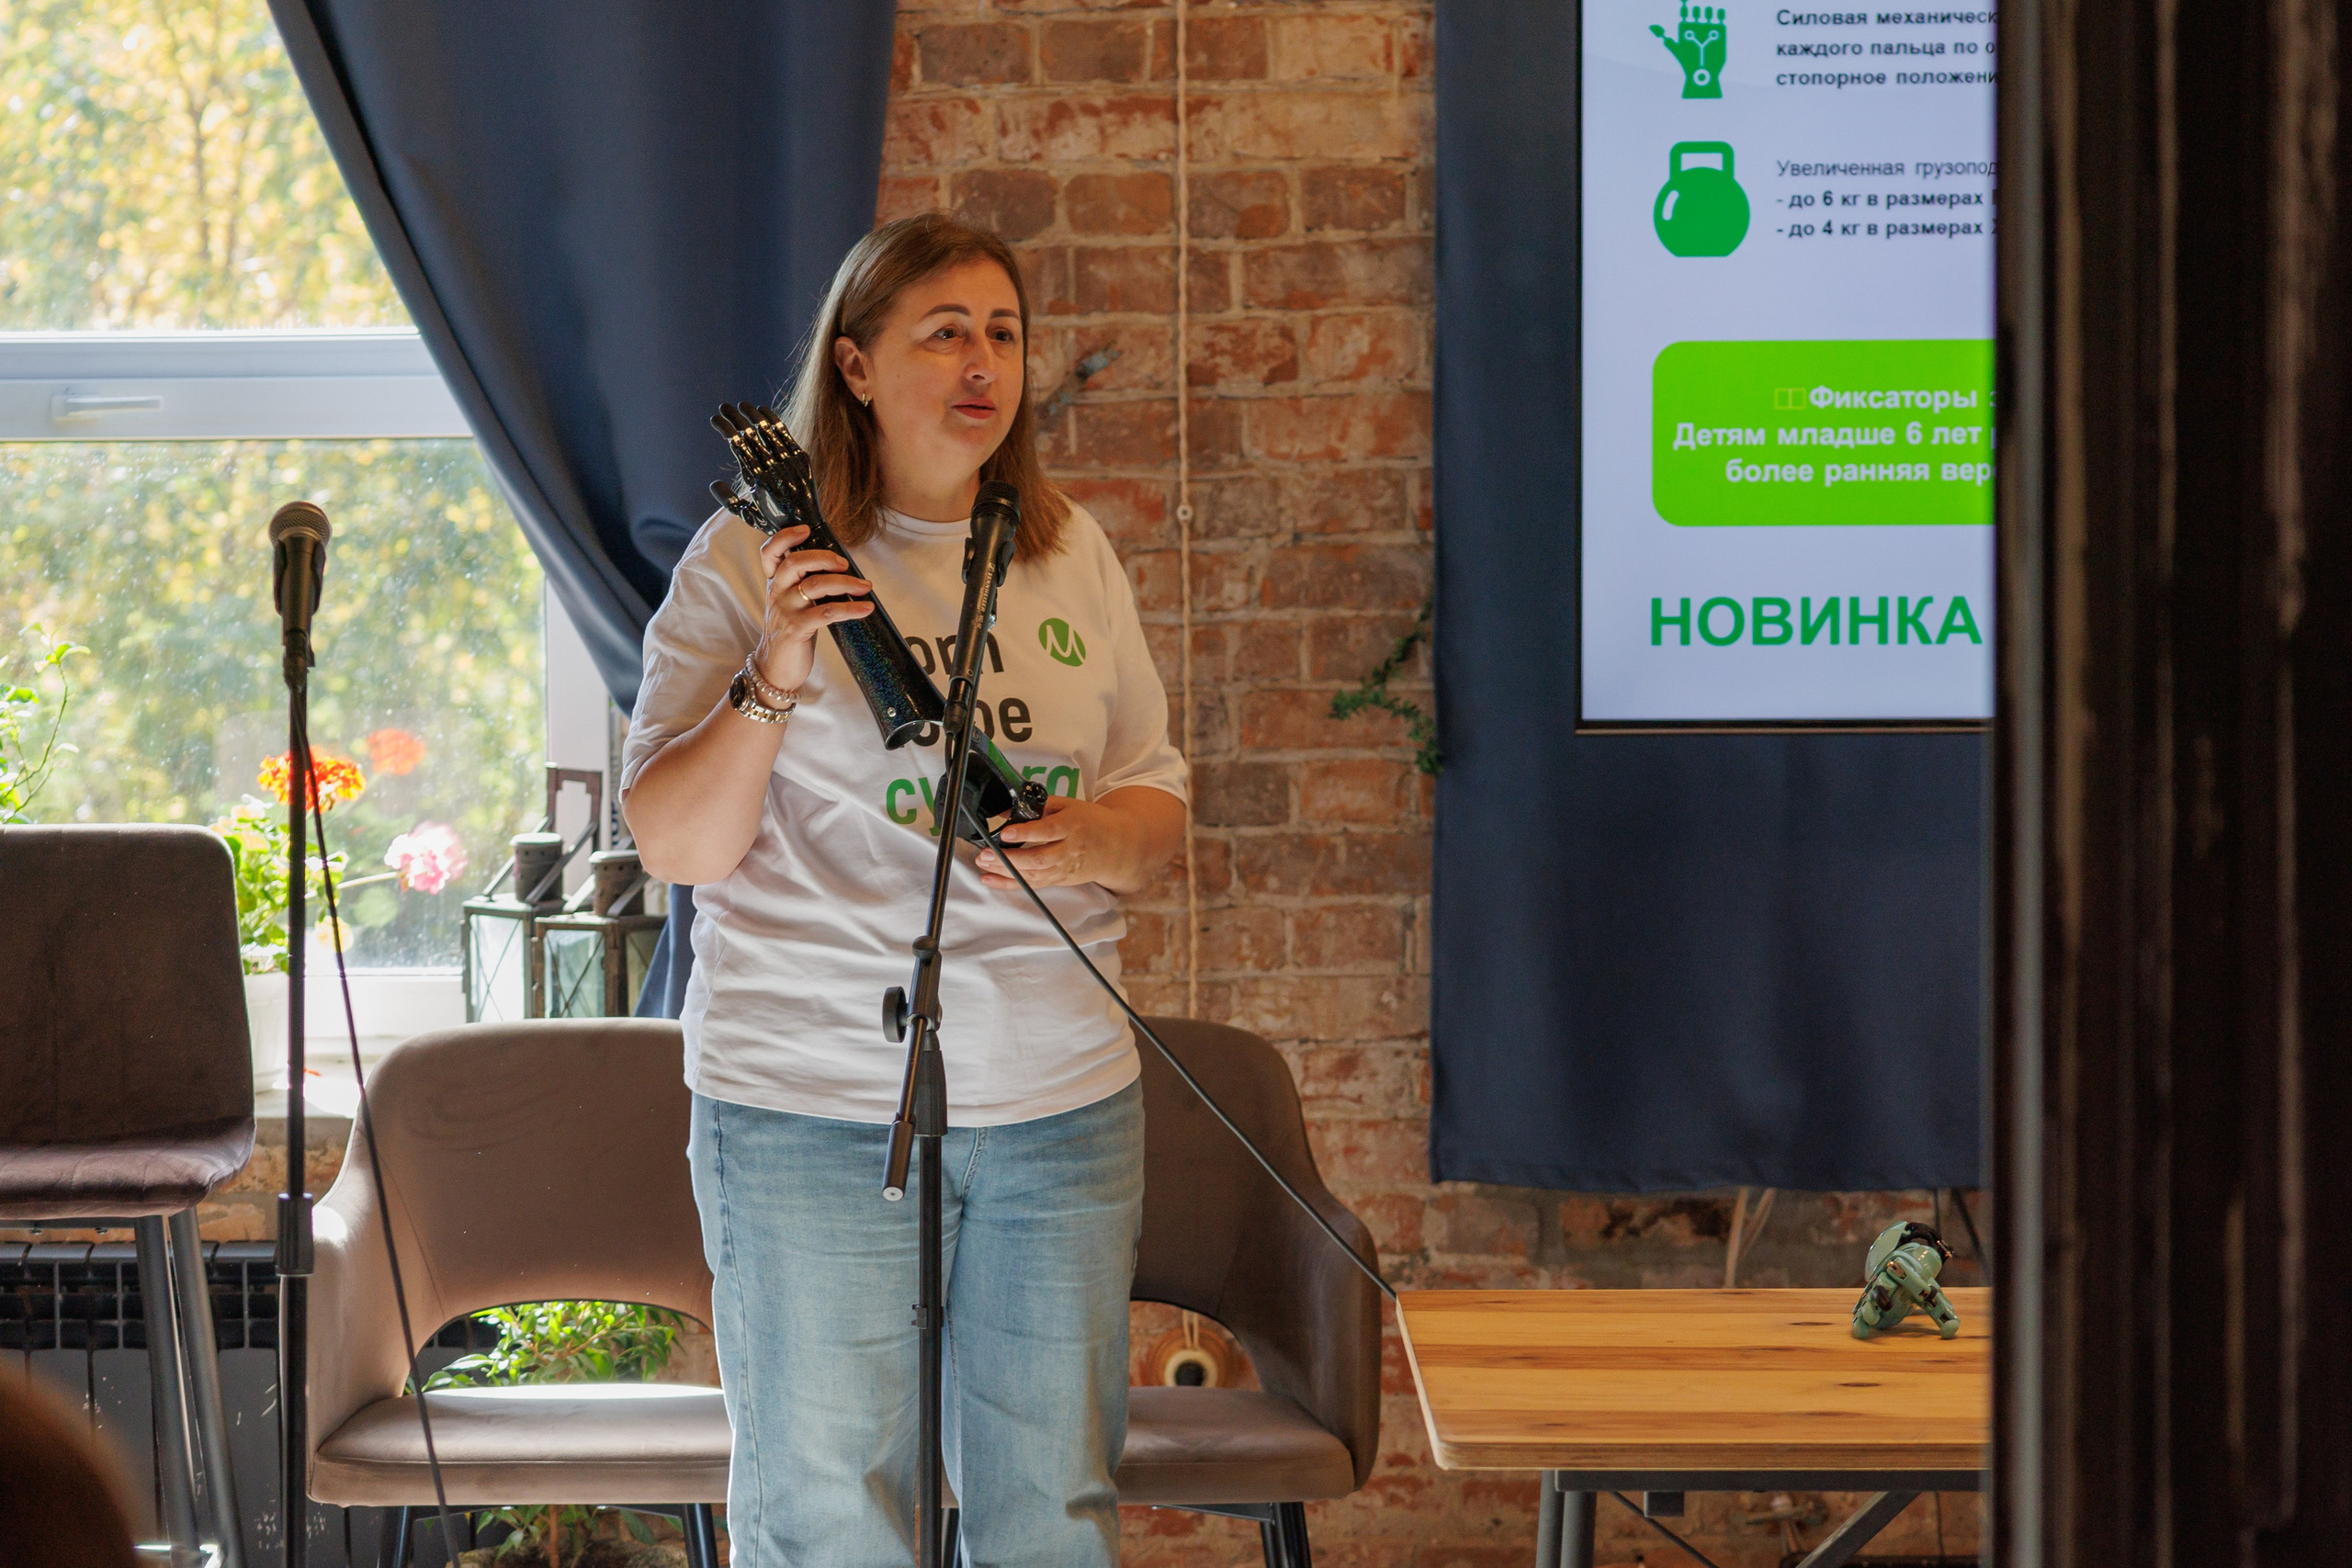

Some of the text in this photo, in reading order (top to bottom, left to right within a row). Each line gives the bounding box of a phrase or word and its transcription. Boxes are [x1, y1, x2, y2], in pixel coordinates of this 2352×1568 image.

[1776, 8, 1868, 26] Силовая
[1776, 42, 1863, 58] каждого
[1870, 42, 1946, 58] пальца
[1953, 42, 1978, 55] по
[1776, 72, 1887, 89] стопорное
[1777, 160, 1905, 176] Увеличенная
[1788, 194, 1815, 209] до
[1822, 190, 1834, 207] 6
[1841, 194, 1860, 207] кг
[1866, 194, 1879, 207] в
[1885, 193, 1984, 211] размерах
[1788, 223, 1815, 239] до
[1822, 220, 1834, 235] 4
[1840, 223, 1860, 236] кг
[1866, 223, 1879, 236] в
[1885, 222, 1984, 241] размерах
[1808, 386, 1977, 414] Фиксаторы
[1672, 422, 1766, 451] Детям
[1777, 426, 1895, 449] младше
[1905, 422, 1923, 446] 6
[1931, 426, 1983, 446] лет
[1725, 458, 1815, 483] более
[1825, 463, 1930, 488] ранняя
[979, 571, 993, 613] SENNHEISER
[1651, 595, 1983, 647] НОВИНКА
